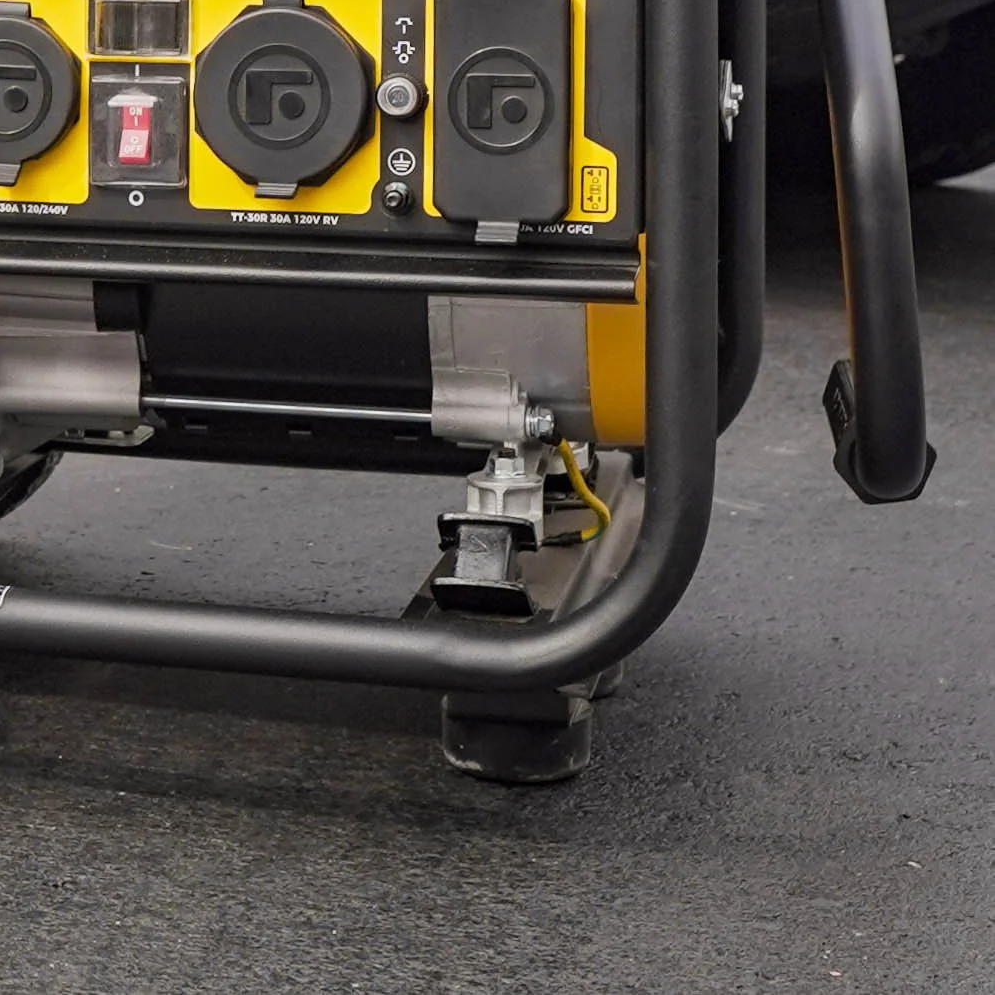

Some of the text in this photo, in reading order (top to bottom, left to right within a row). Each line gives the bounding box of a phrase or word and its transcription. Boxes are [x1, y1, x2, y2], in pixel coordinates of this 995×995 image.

[129, 106, 143, 116] ON
[124, 144, 142, 154] OFF
[0, 202, 19, 213] 30A
[22, 203, 68, 215] 120/240V
[230, 211, 339, 225] TT-30R 30A 120V RV
[566, 224, 594, 234] GFCI
